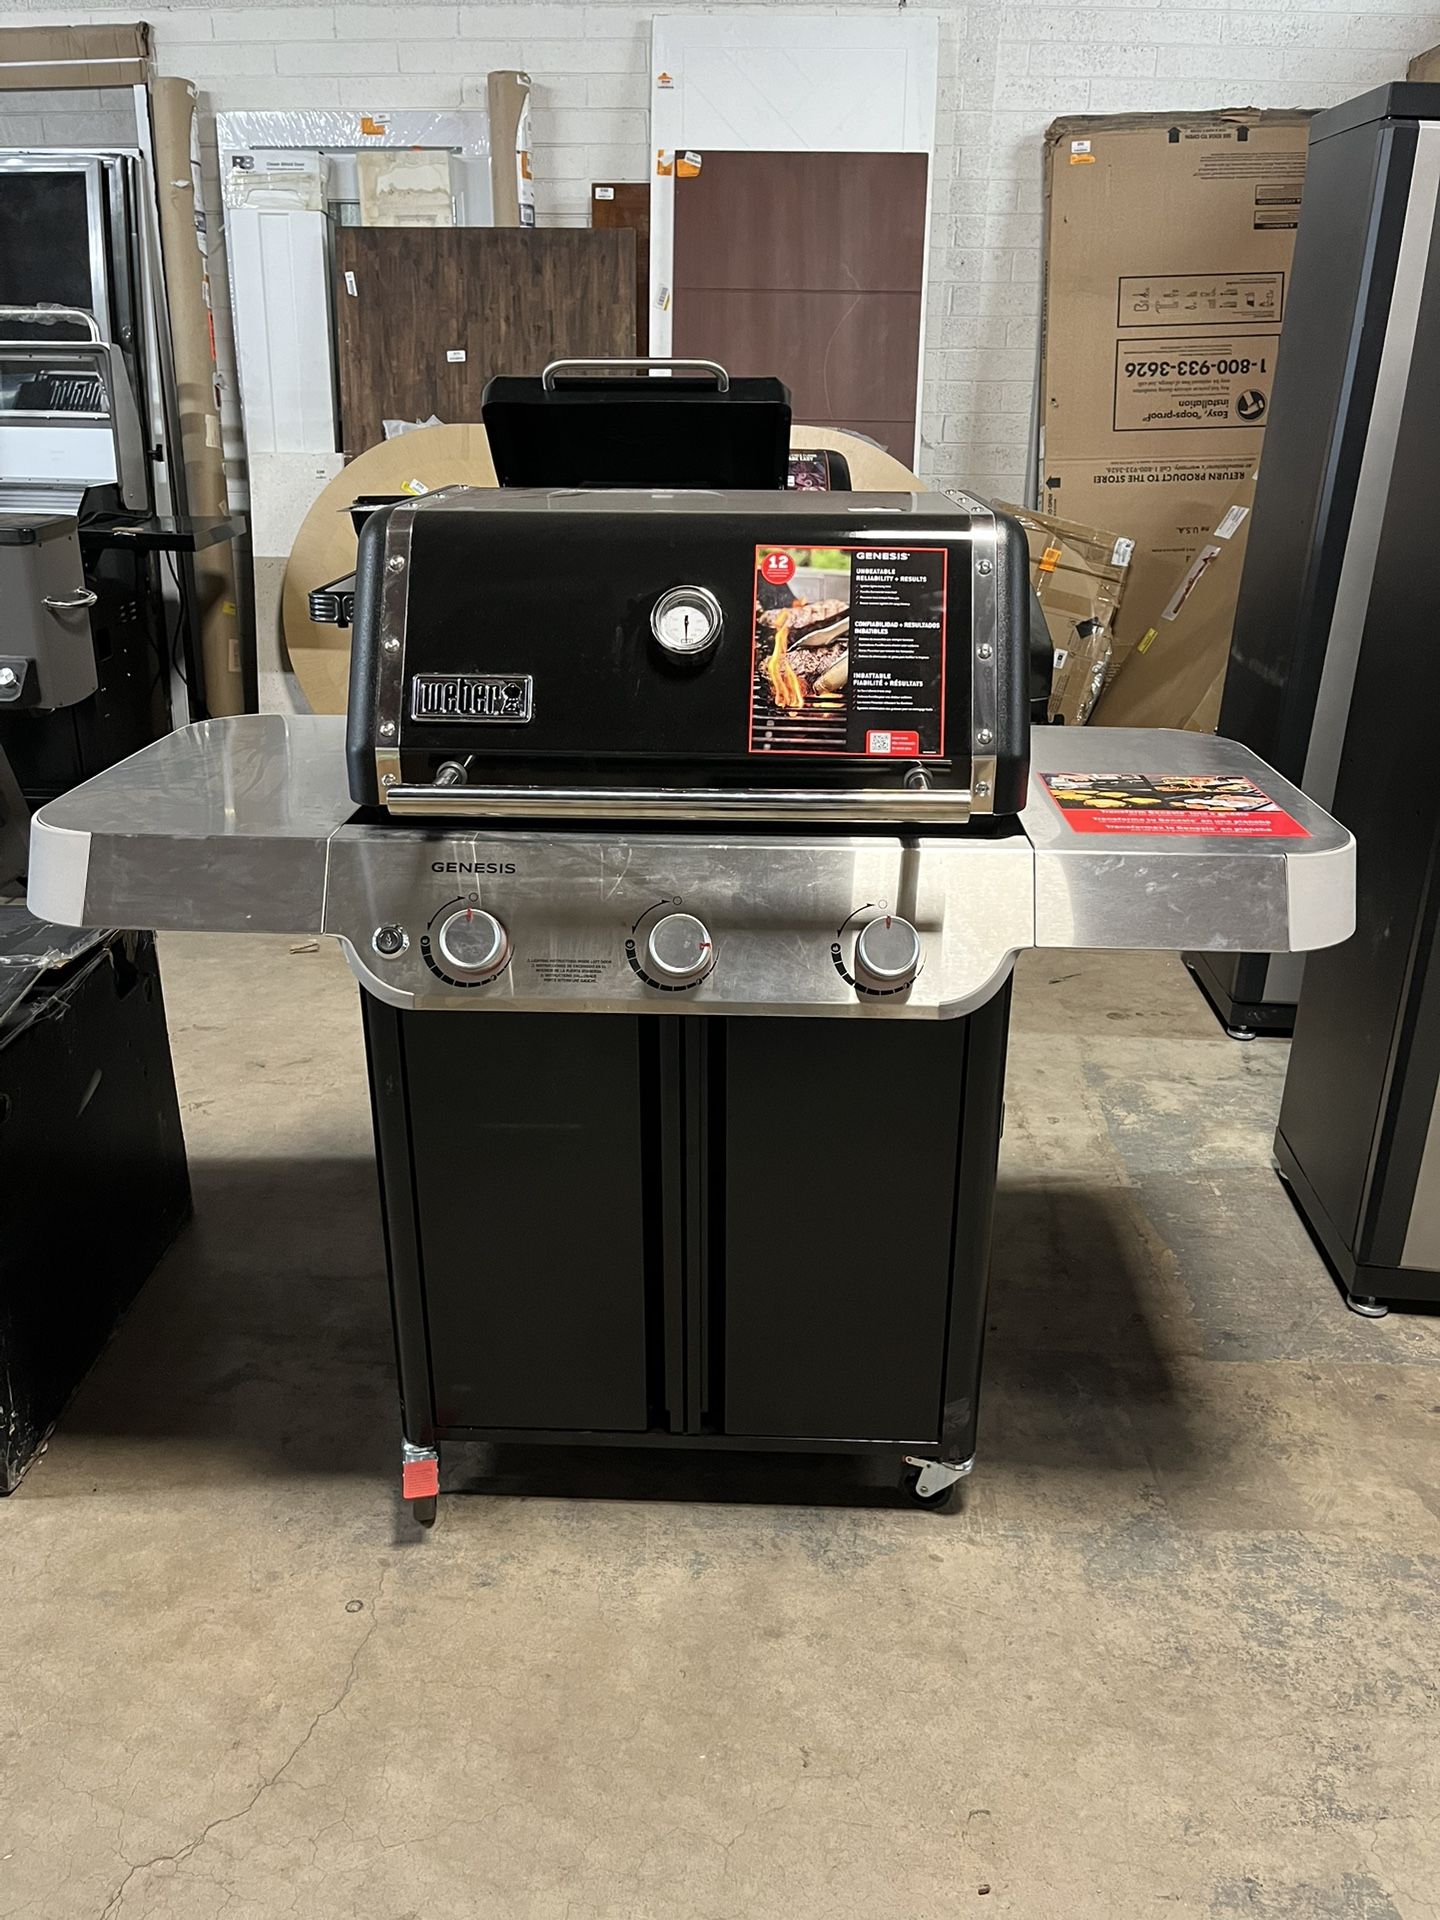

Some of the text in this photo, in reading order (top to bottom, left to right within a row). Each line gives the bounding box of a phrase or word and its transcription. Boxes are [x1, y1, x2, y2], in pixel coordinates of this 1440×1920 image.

[1124, 358, 1266, 377] 1-800-933-3626
[1178, 399, 1229, 409] installation
[1204, 410, 1228, 420] Easy,
[1094, 472, 1244, 484] RETURN PRODUCT TO THE STORE!
[856, 552, 908, 560] GENESIS
[768, 555, 788, 568] 12
[853, 672, 892, 680] IMBATTABLE
[890, 679, 924, 687] RÉSULTATS
[432, 862, 516, 874] GENESIS
